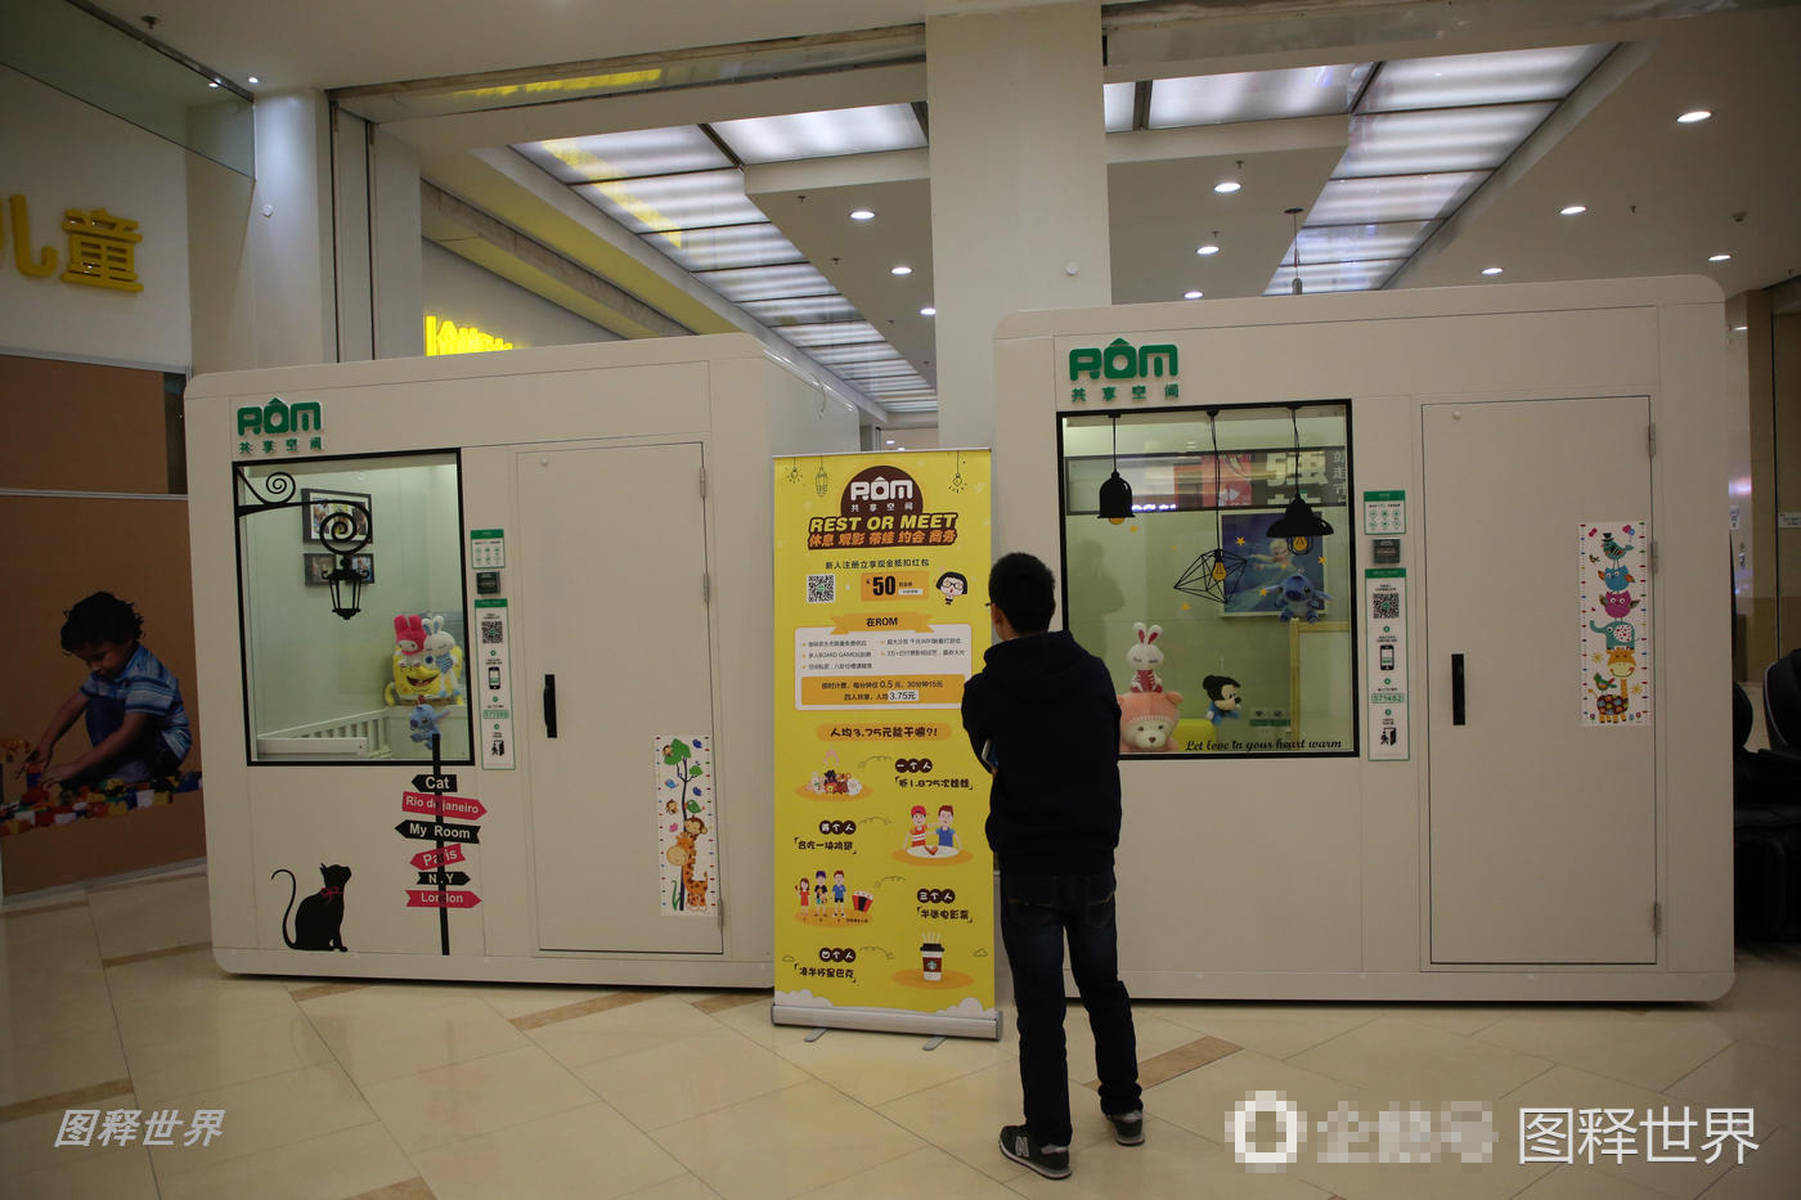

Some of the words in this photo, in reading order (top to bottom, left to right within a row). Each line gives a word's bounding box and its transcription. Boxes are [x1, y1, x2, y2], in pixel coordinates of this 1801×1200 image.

[1071, 383, 1180, 403] 共享空间
[239, 437, 322, 454] 共享空间
[850, 502, 914, 513] 共享空间
[810, 517, 863, 533] REST
[866, 516, 895, 531] OR
[900, 513, 958, 530] MEET
[808, 534, 835, 548] 休息
[1184, 740, 1204, 751] Let
[1206, 740, 1230, 751] love
[1245, 742, 1273, 752] your
[1275, 738, 1306, 750] heart
[1308, 739, 1343, 749] warm
[896, 760, 932, 771] 一个人
[425, 776, 450, 790] Cat
[406, 796, 424, 807] Rio
[409, 822, 427, 835] My
[434, 825, 471, 839] Room
[919, 891, 954, 902] 三个人
[820, 949, 855, 960] 四个人
